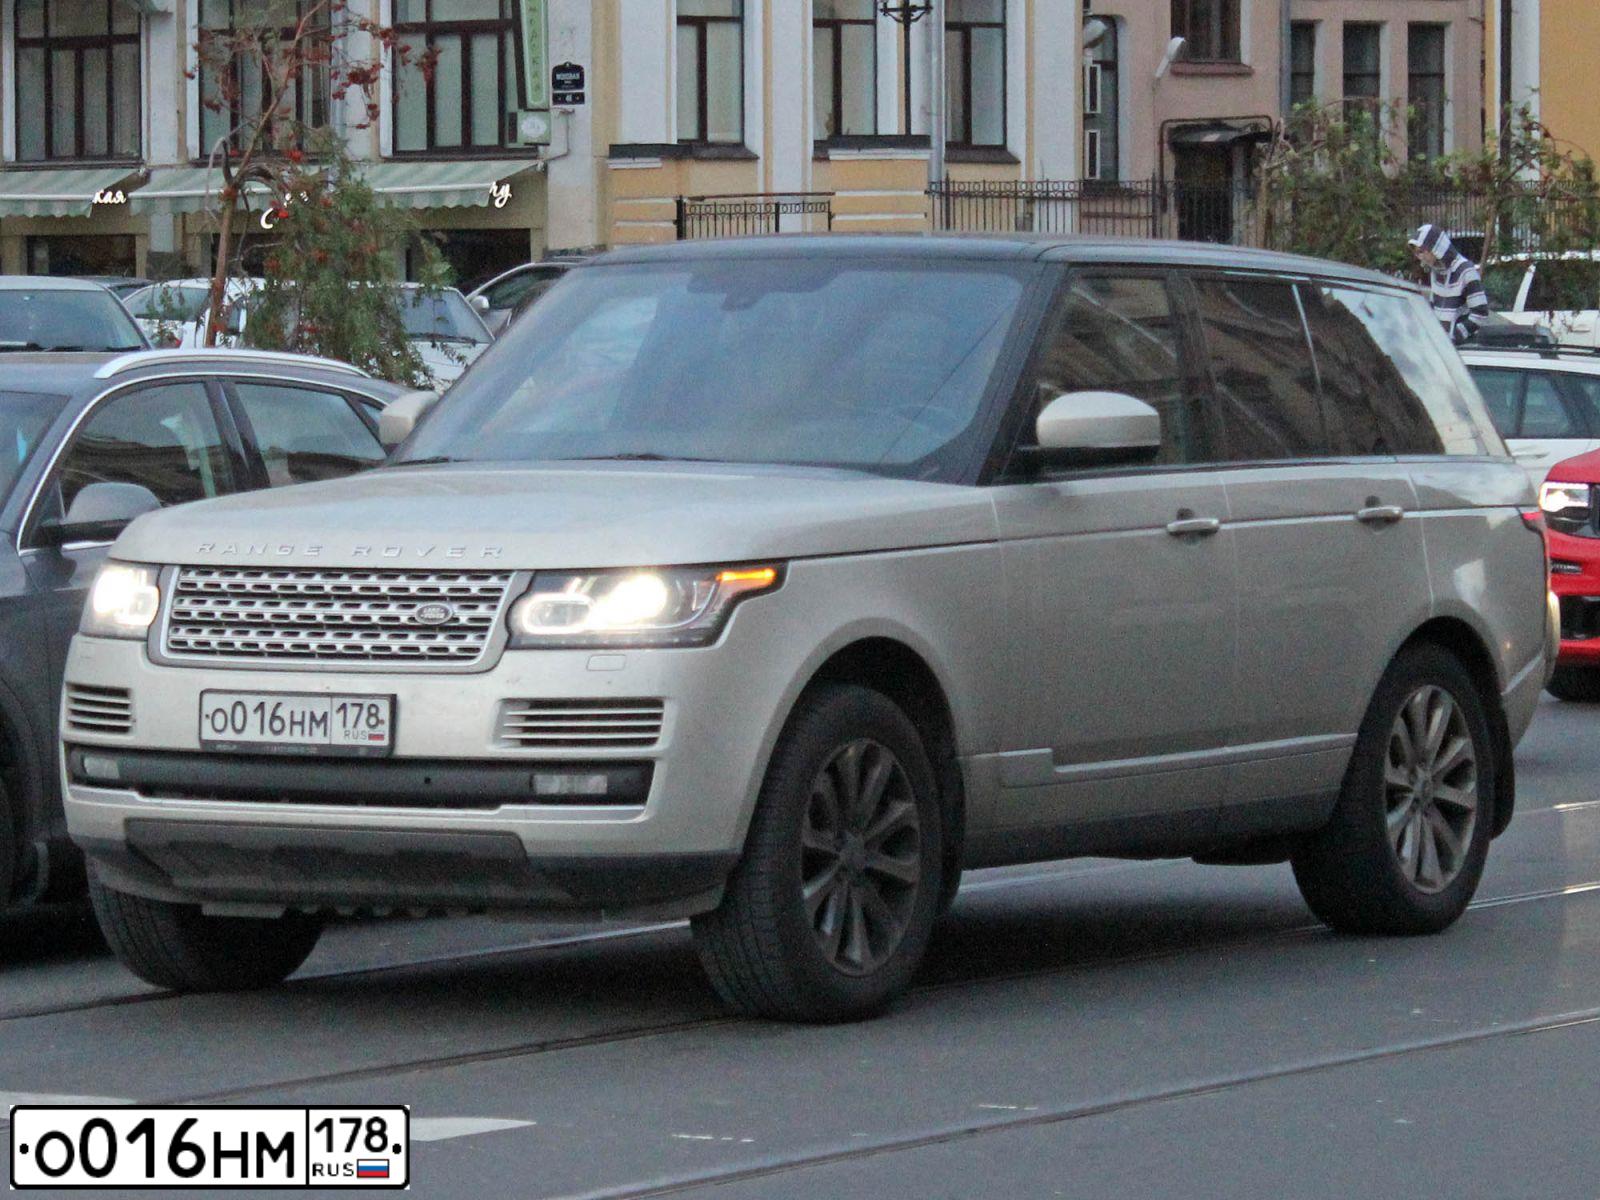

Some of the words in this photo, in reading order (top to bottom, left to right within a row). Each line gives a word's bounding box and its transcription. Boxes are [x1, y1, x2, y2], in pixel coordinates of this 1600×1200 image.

[196, 543, 323, 556] RANGE
[352, 545, 503, 559] ROVER
[336, 702, 379, 729] 178
[344, 730, 368, 741] RUS
